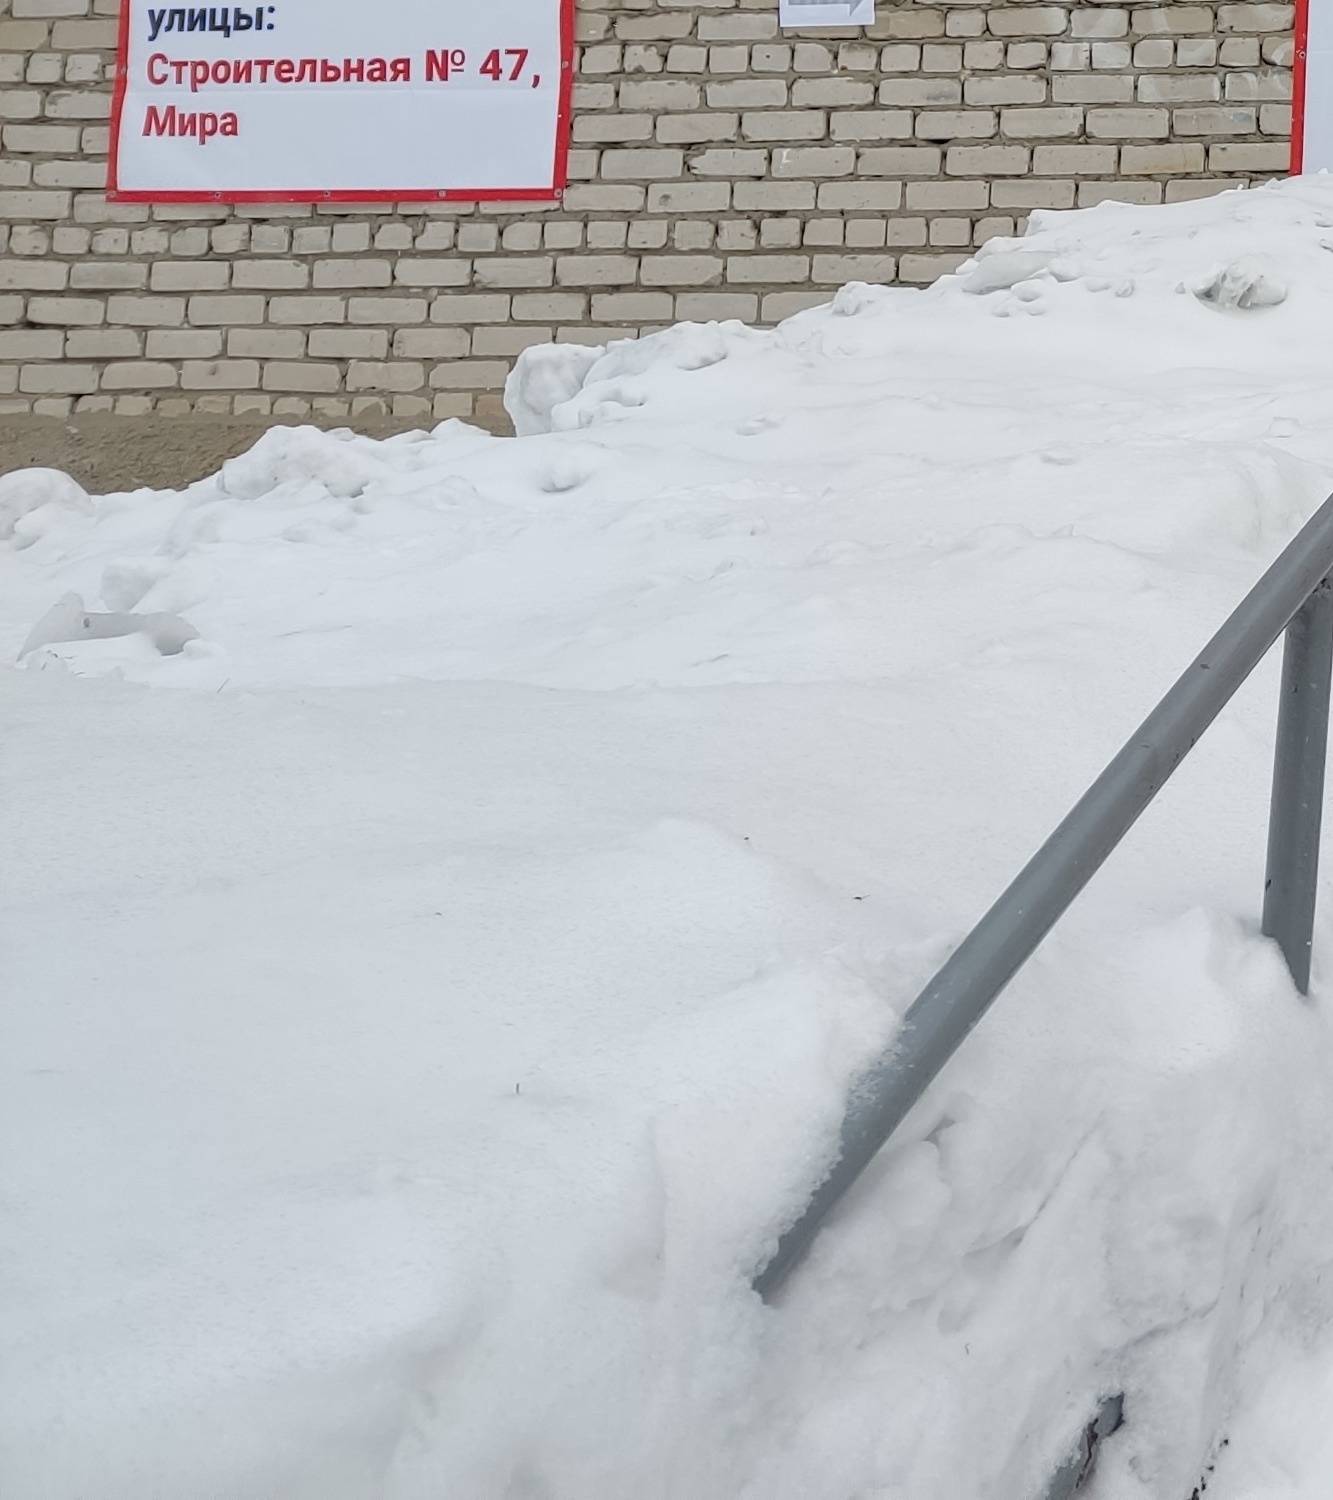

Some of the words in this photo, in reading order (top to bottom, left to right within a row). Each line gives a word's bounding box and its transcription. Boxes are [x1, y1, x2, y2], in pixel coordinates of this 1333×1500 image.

[148, 6, 275, 41] улицы:
[147, 52, 410, 92] Строительная
[425, 49, 466, 81] №
[479, 49, 541, 88] 47,
[142, 105, 238, 145] Мира
